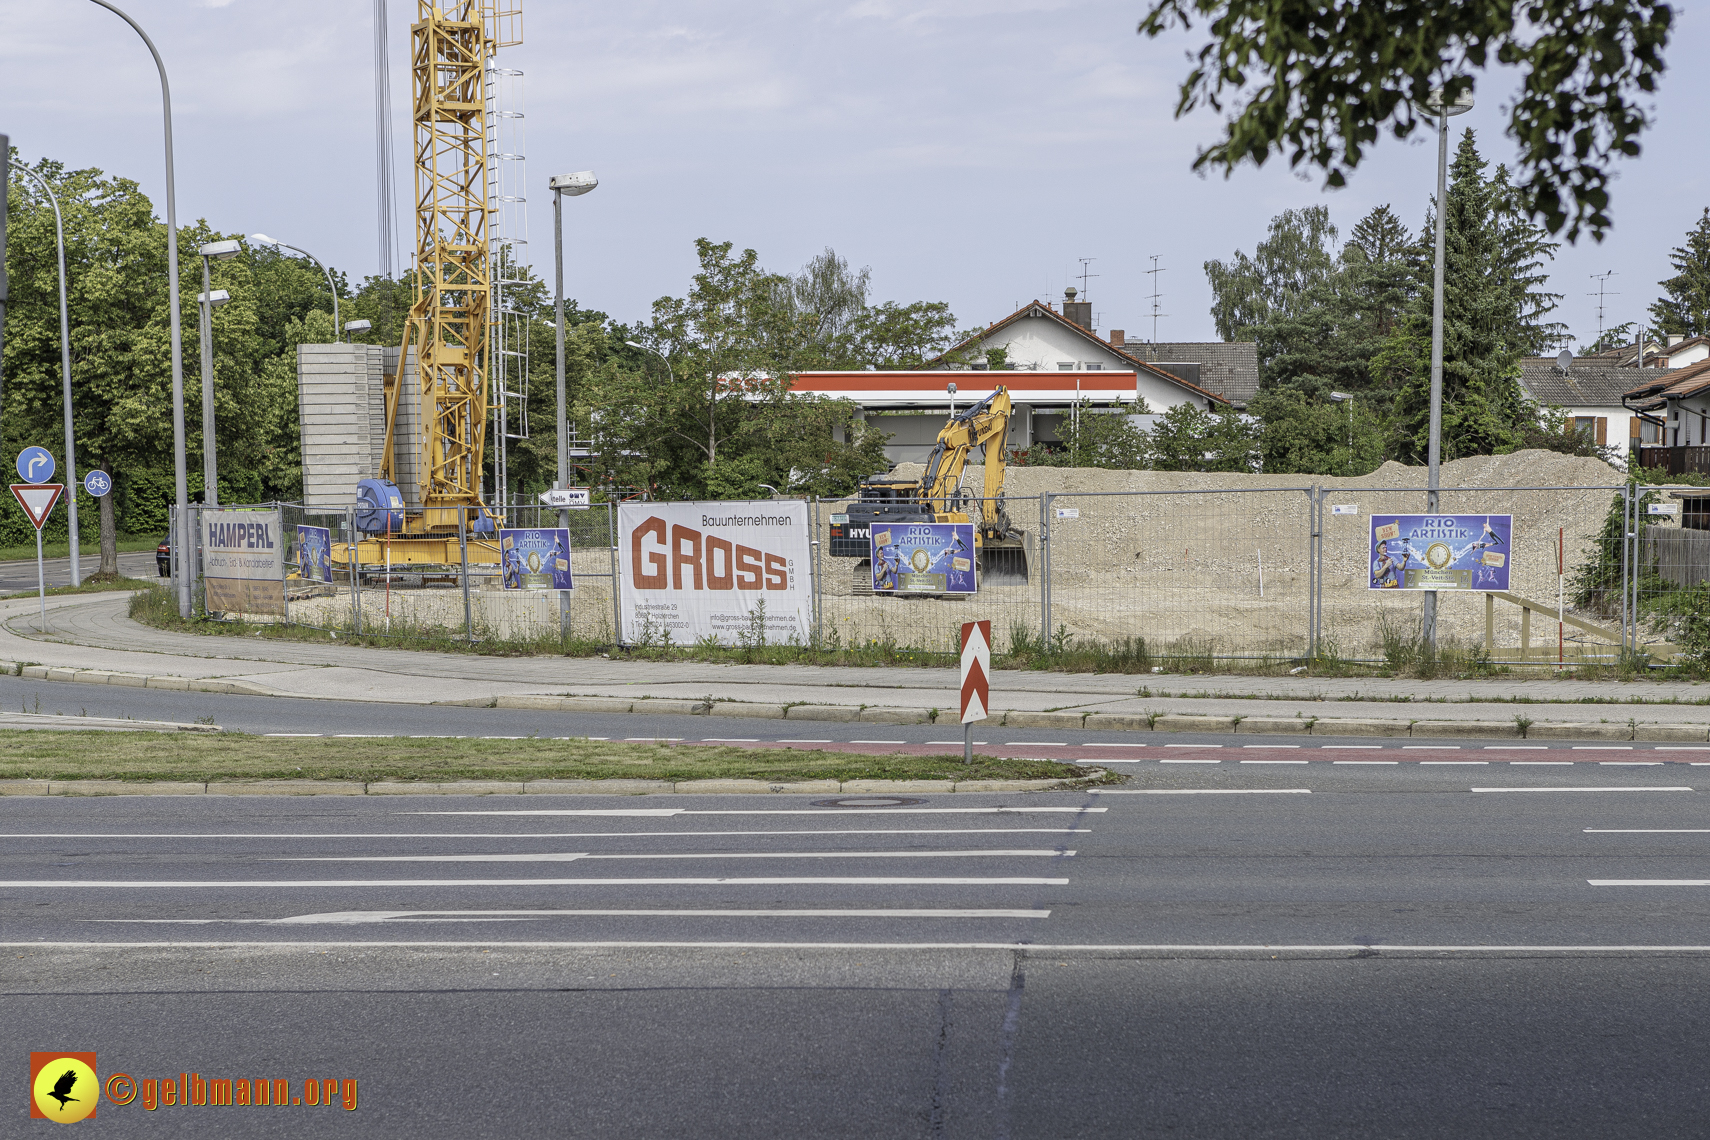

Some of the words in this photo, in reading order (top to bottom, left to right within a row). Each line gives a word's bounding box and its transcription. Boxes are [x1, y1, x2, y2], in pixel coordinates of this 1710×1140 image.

[551, 495, 566, 503] telle
[702, 514, 792, 526] Bauunternehmen
[1424, 518, 1455, 528] RIO
[208, 522, 274, 548] HAMPERL
[909, 527, 931, 536] RIO
[1410, 528, 1468, 538] ARTISTIK
[520, 540, 548, 548] ARTISTIK
[900, 537, 940, 546] ARTISTIK
[632, 516, 788, 590] GROSS
